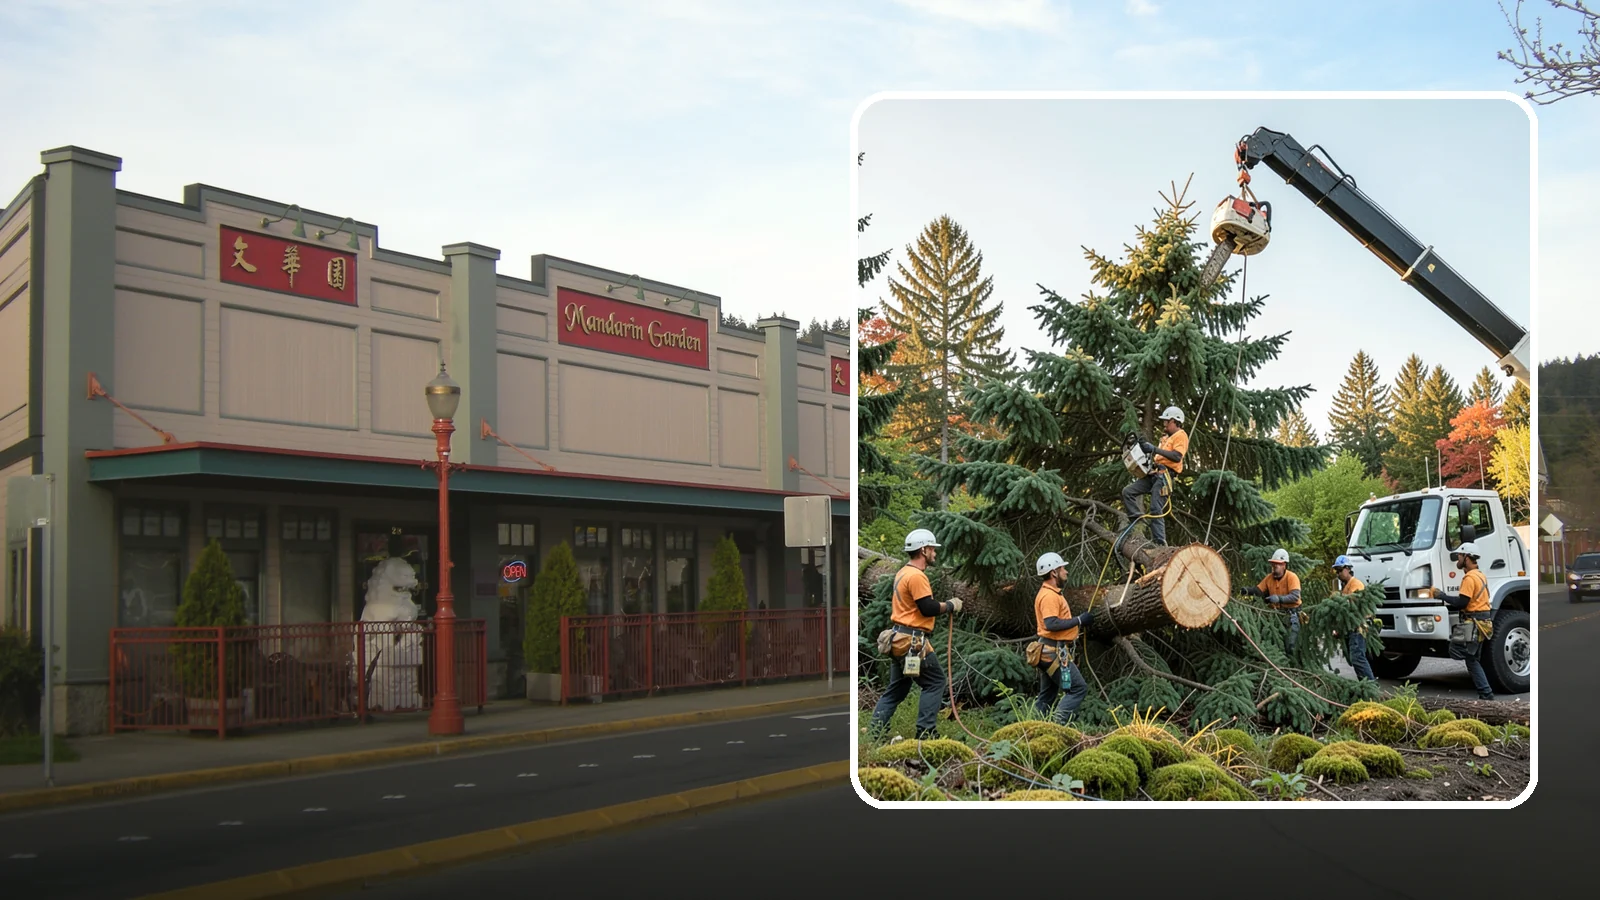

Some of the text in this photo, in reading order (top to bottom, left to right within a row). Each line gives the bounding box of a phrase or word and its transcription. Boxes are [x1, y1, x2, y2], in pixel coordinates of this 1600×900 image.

[231, 236, 346, 291] 文華園
[565, 302, 701, 352] Mandarin Garden
[503, 565, 527, 578] OPEN
